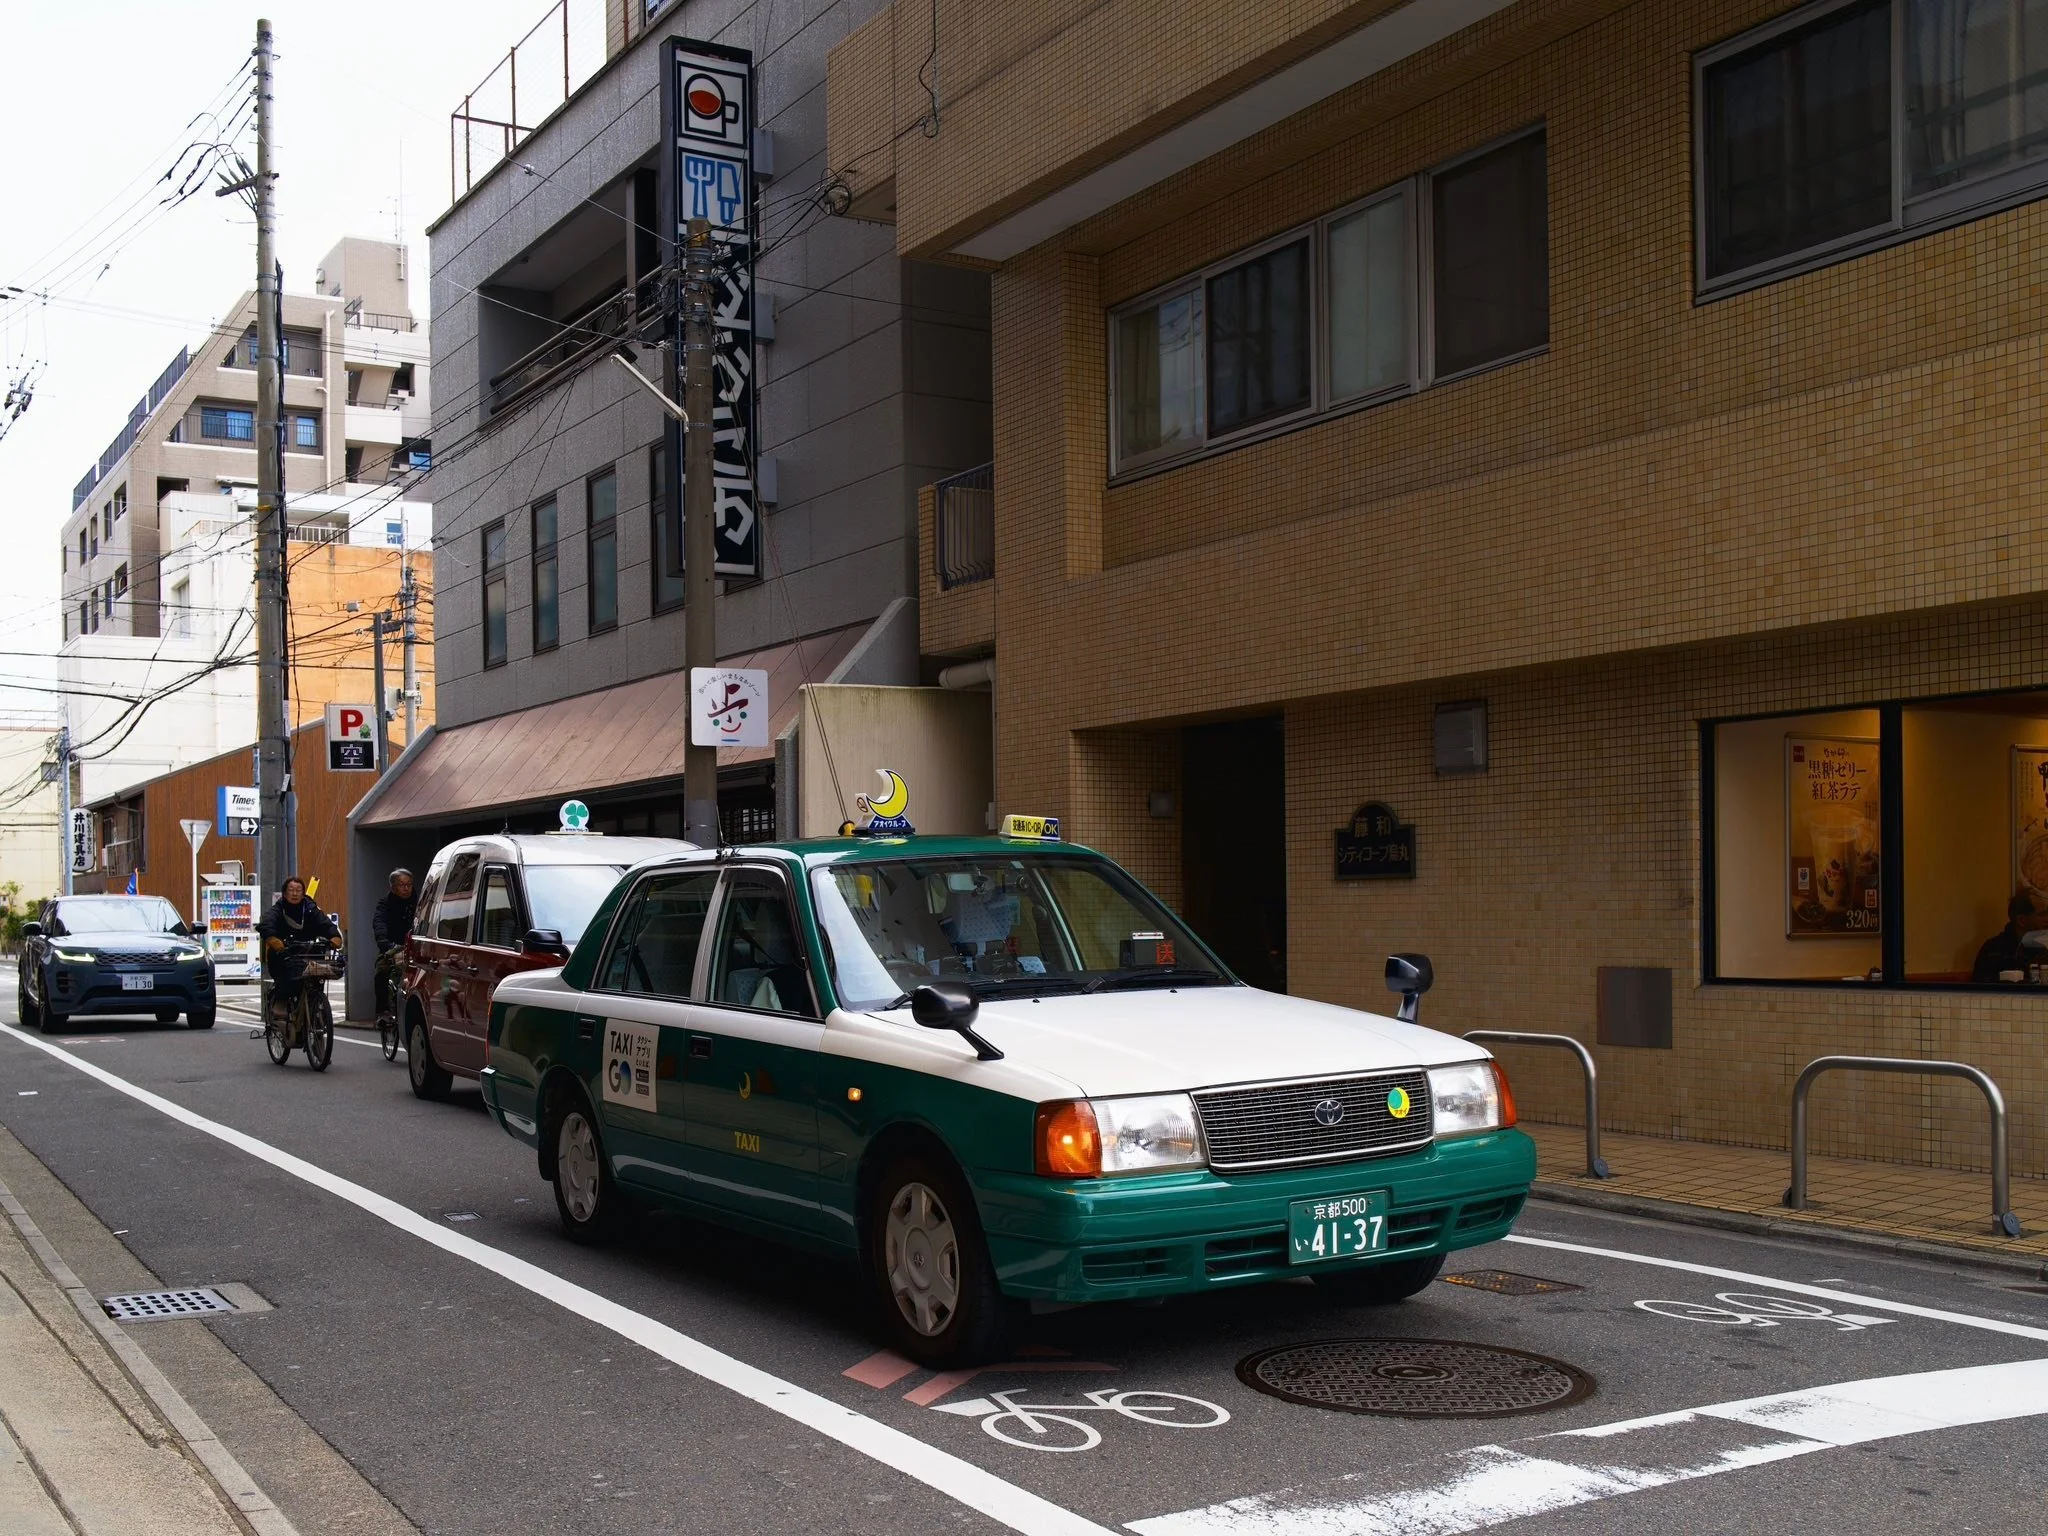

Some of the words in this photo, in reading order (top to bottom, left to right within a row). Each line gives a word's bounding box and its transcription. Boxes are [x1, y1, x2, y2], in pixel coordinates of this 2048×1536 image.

[340, 709, 364, 737] P
[340, 743, 364, 766] 空
[1808, 759, 1867, 780] 黒糖ゼリー
[232, 794, 256, 805] Times
[1811, 781, 1862, 801] 紅茶ラテ
[73, 812, 86, 867] 井川建具店
[1044, 823, 1058, 835] OK
[610, 1031, 634, 1057] TAXI
[636, 1046, 651, 1059] アプリ
[734, 1131, 760, 1153] TAXI
[1313, 1197, 1367, 1220] 京都500
[1294, 1237, 1309, 1252] い
[1311, 1215, 1383, 1257] 41-37
